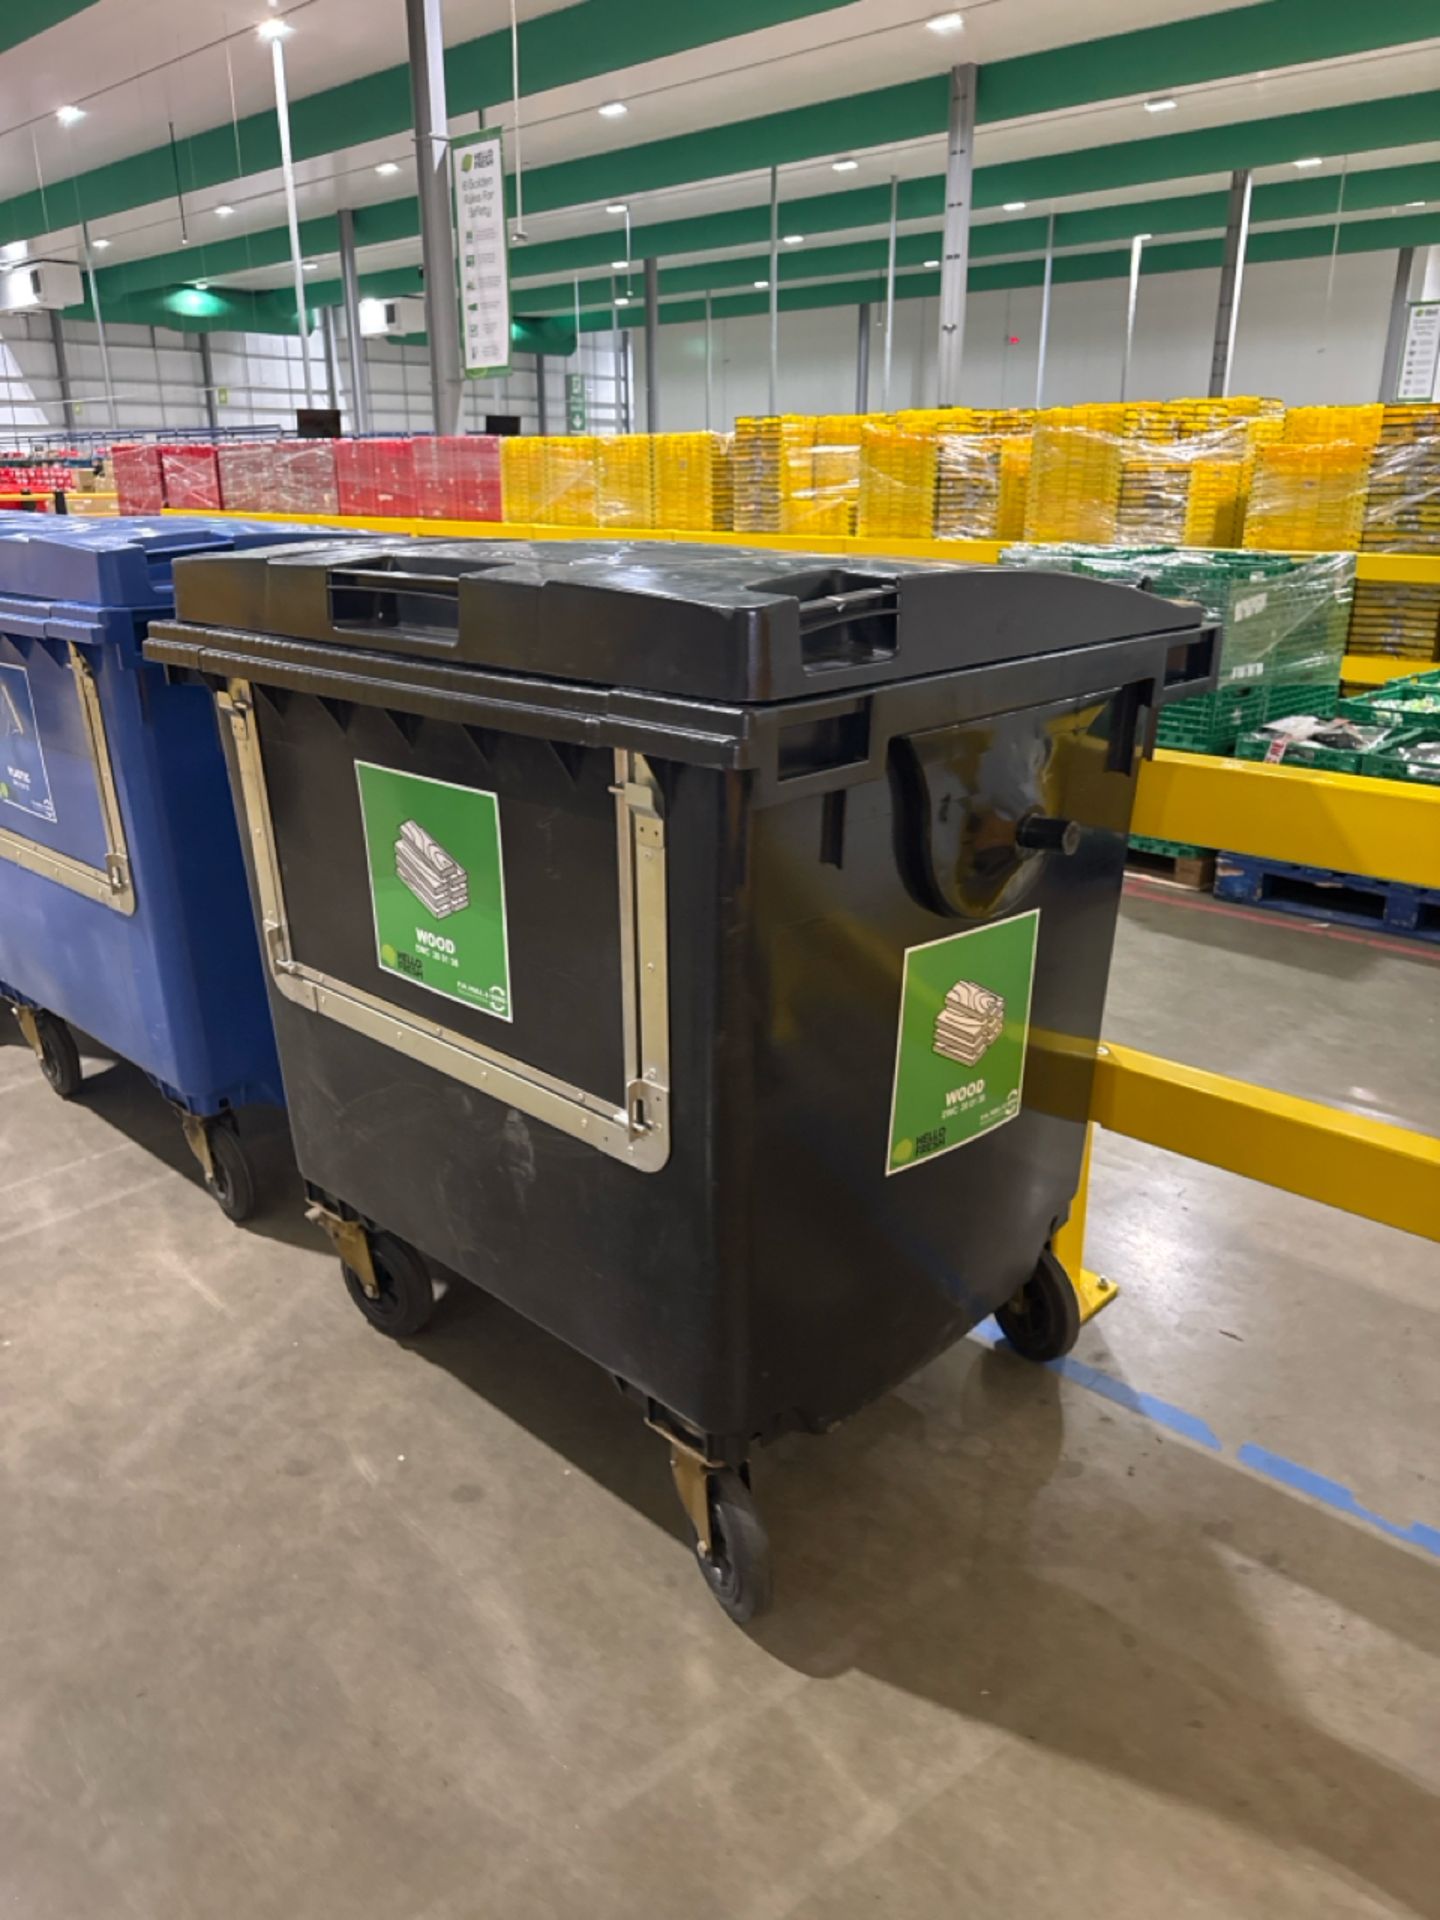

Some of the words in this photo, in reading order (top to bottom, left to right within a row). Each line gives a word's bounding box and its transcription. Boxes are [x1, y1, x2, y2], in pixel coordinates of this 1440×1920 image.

[415, 927, 456, 954] WOOD
[398, 951, 423, 969] HELLO
[398, 960, 424, 980] FRESH
[945, 1079, 985, 1107] WOOD
[916, 1126, 947, 1146] HELLO
[916, 1136, 946, 1156] FRESH
